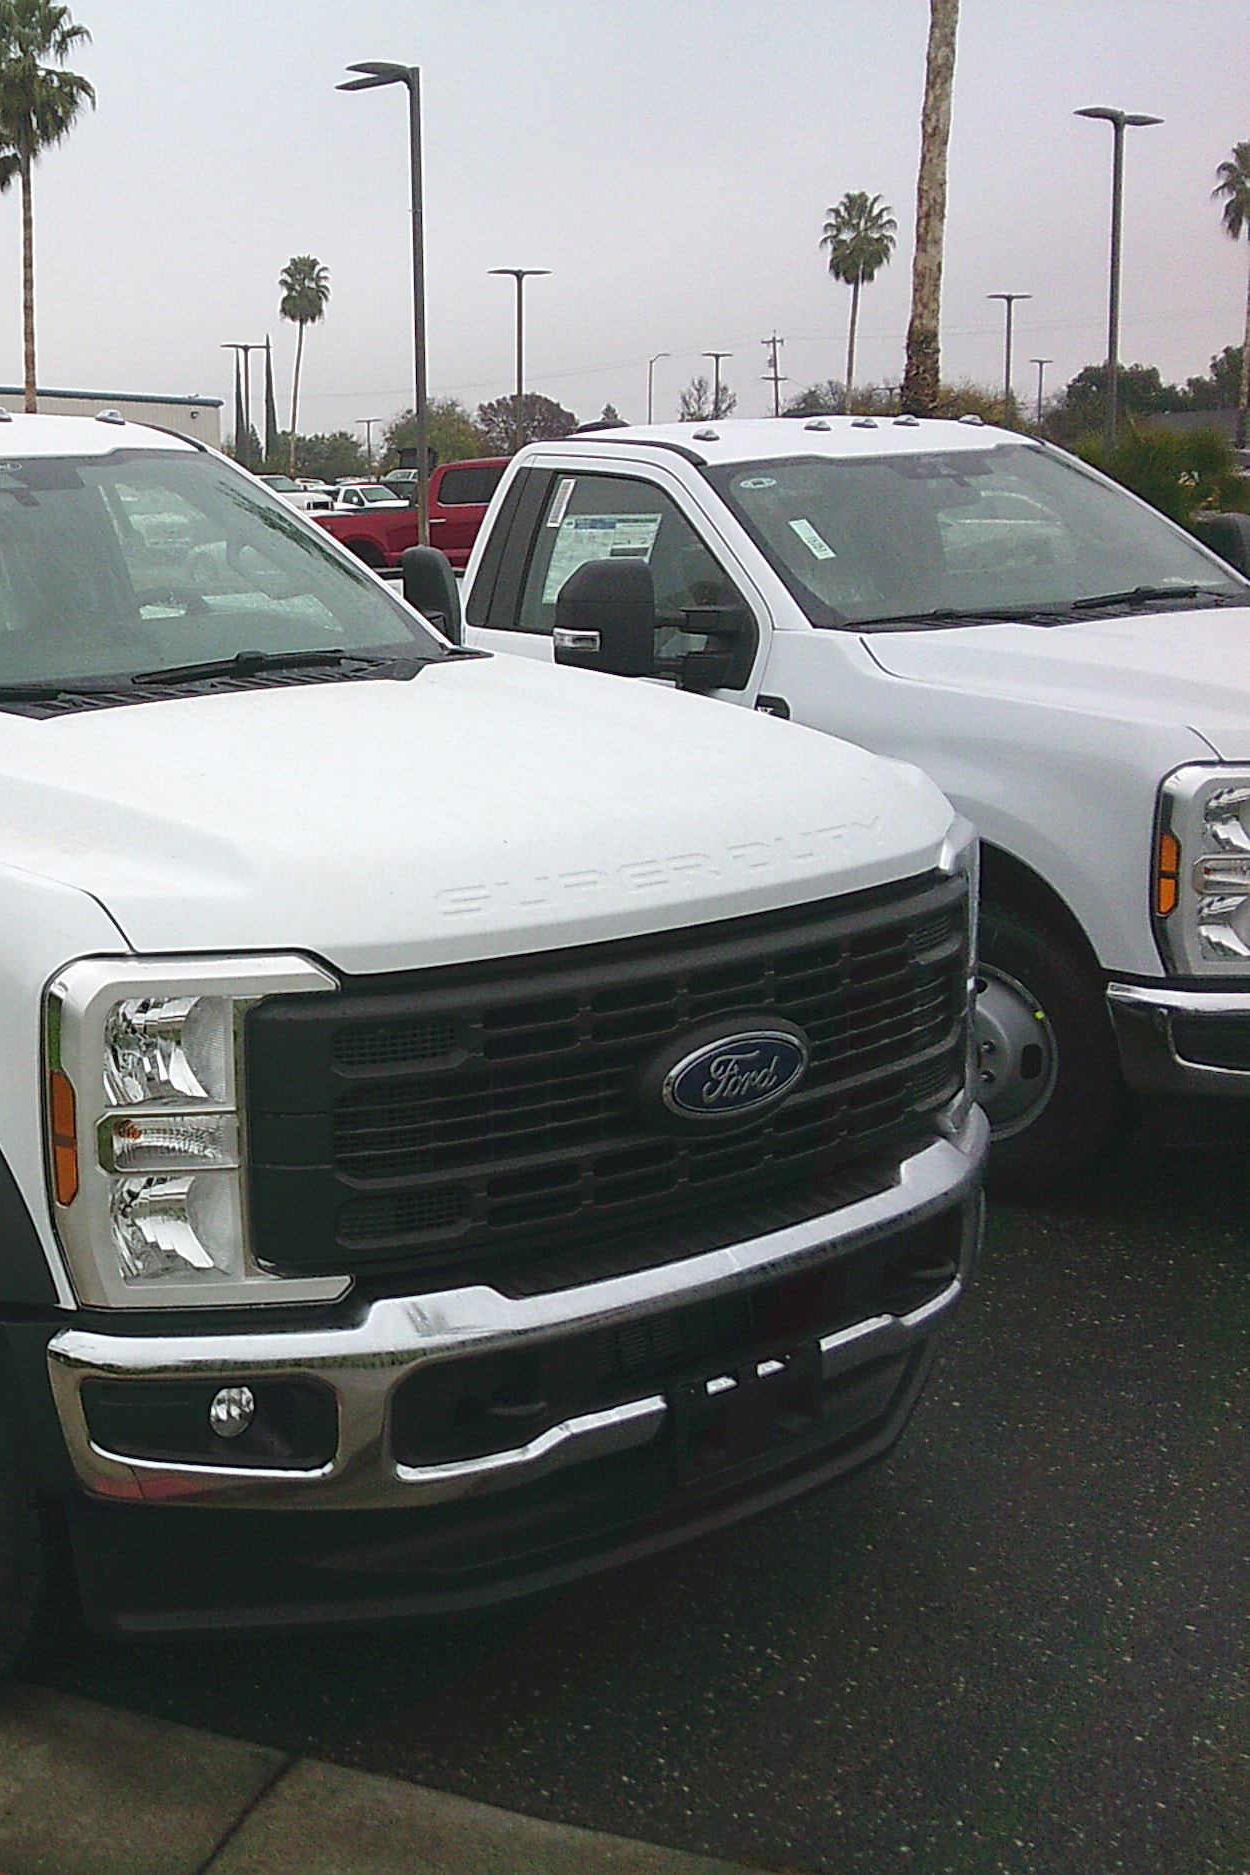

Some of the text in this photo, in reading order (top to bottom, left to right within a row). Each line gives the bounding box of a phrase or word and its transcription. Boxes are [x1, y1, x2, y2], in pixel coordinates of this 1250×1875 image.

[435, 815, 882, 919] SUPER DUTY
[702, 1049, 781, 1103] Ford
